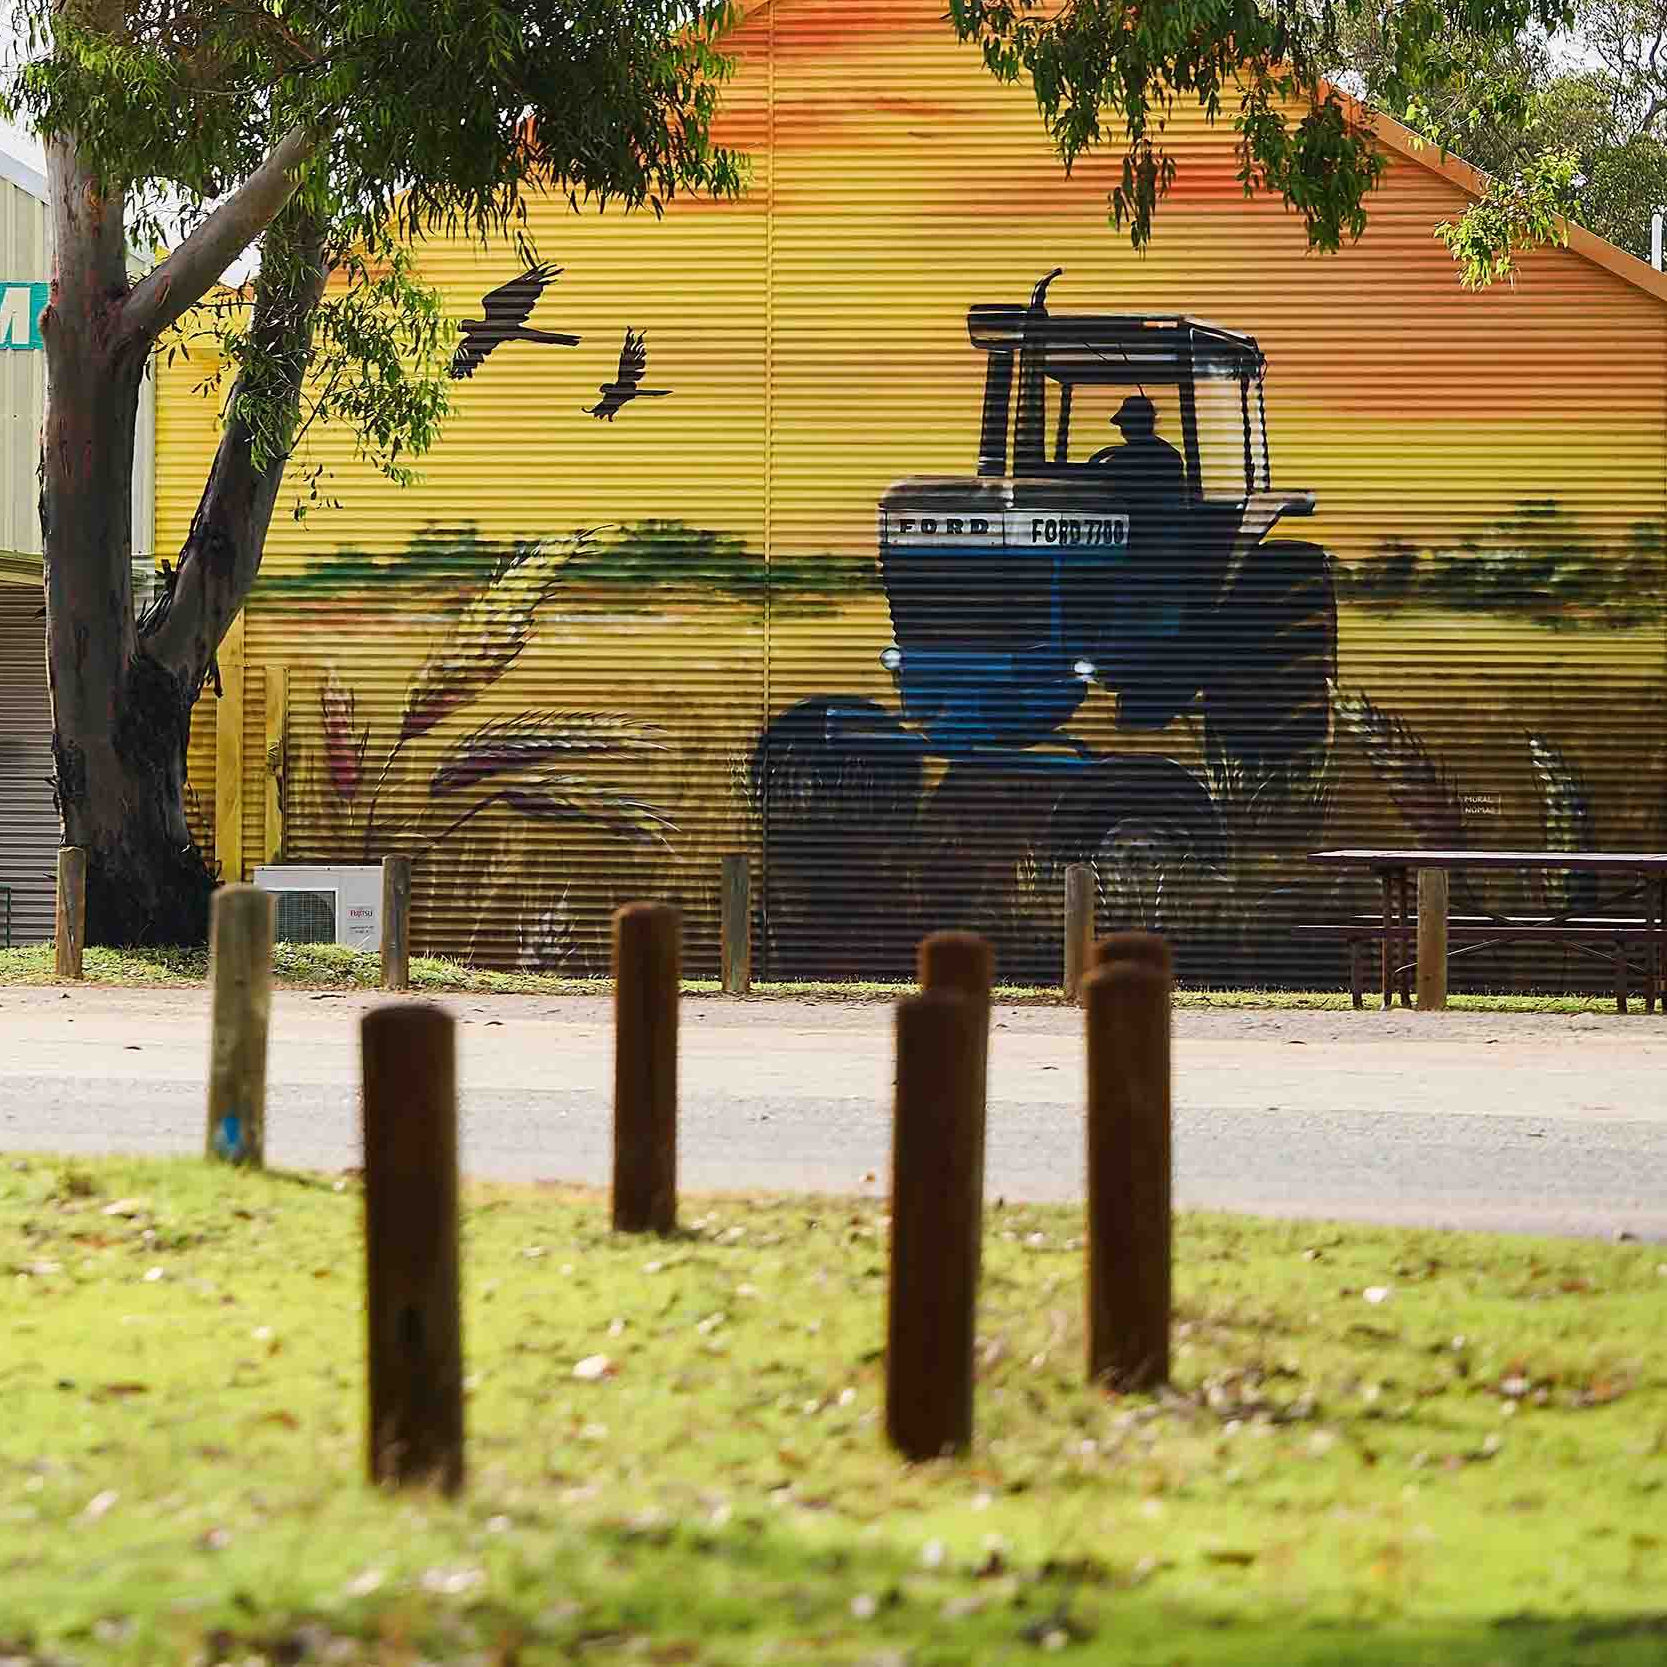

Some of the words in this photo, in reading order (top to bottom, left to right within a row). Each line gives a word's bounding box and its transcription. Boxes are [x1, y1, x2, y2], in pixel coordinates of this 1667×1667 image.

[898, 518, 990, 535] FORD
[1031, 518, 1081, 545] FORD
[1083, 518, 1125, 545] 7700
